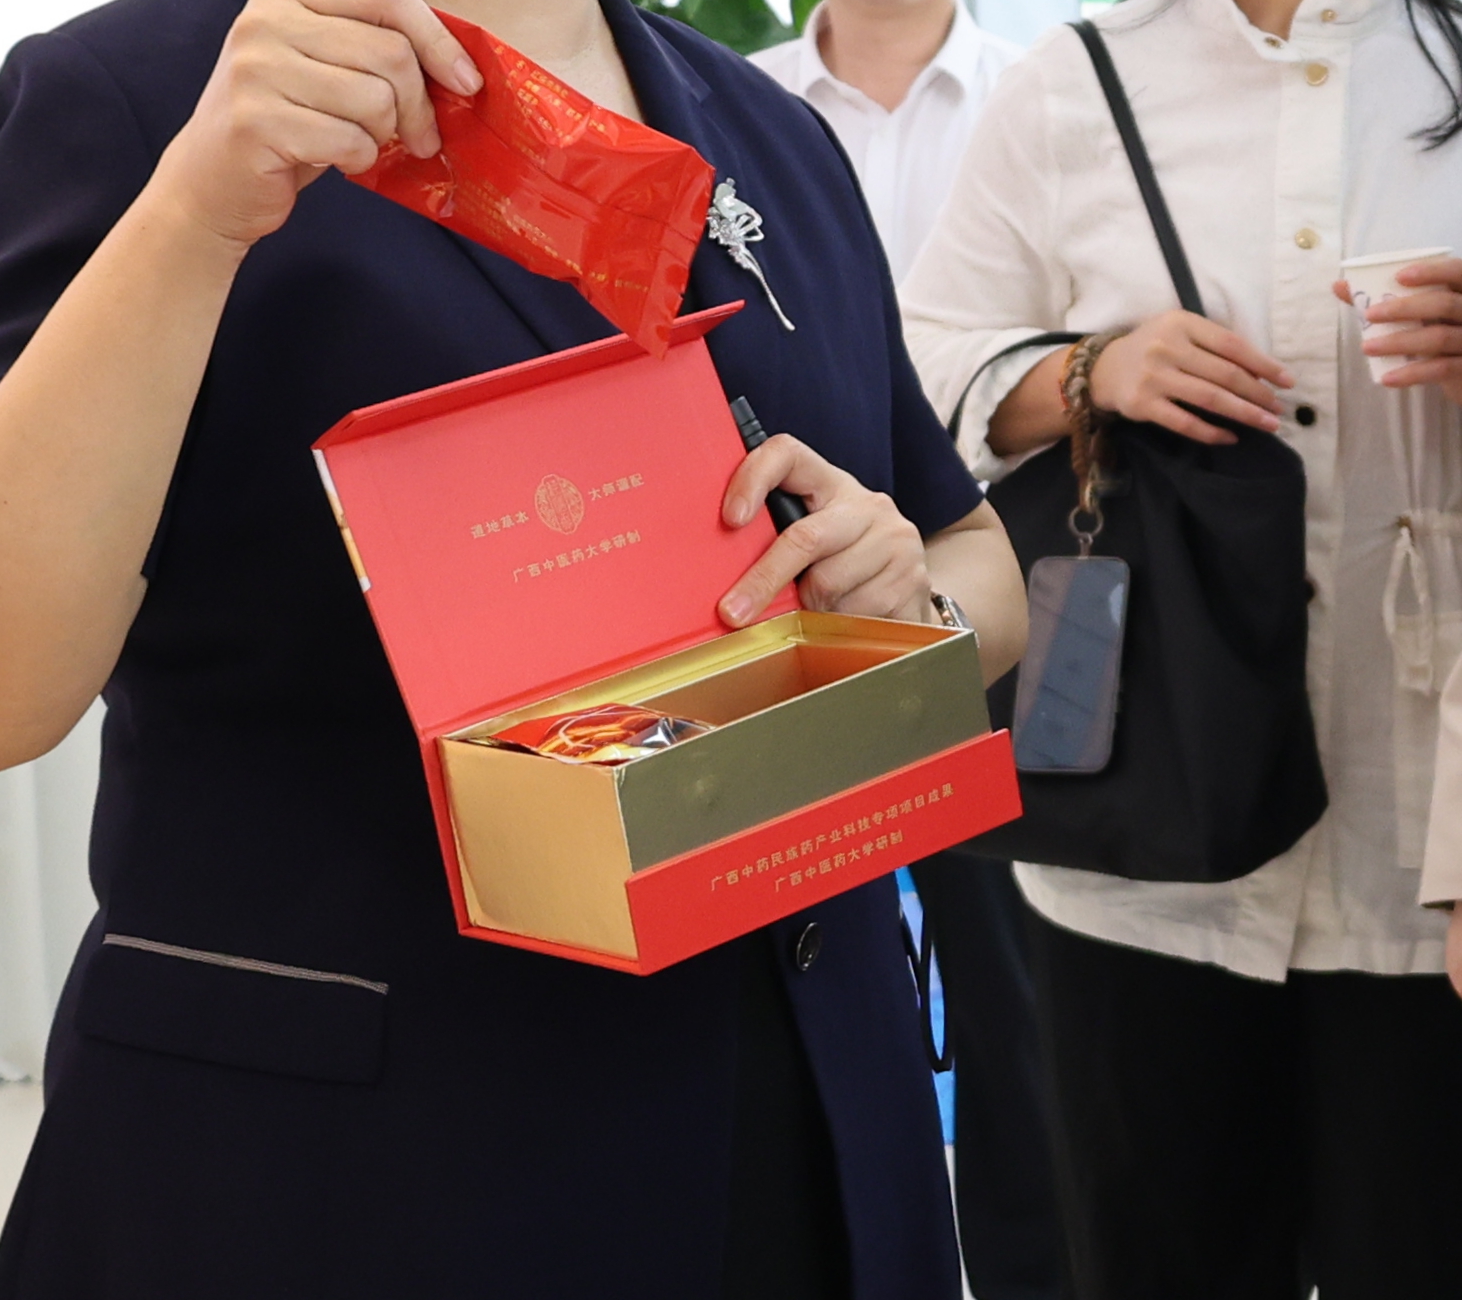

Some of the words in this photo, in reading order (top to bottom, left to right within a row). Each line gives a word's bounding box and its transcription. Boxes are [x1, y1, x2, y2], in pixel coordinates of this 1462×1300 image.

[588, 473, 644, 501] 大师调配
[470, 511, 530, 539] 道地草本
[512, 529, 642, 583] 广西中医药大学研制
[710, 783, 955, 891] 广西中药民族药产业科技专项项目成果
[774, 830, 904, 893] 广西中医药大学研制
